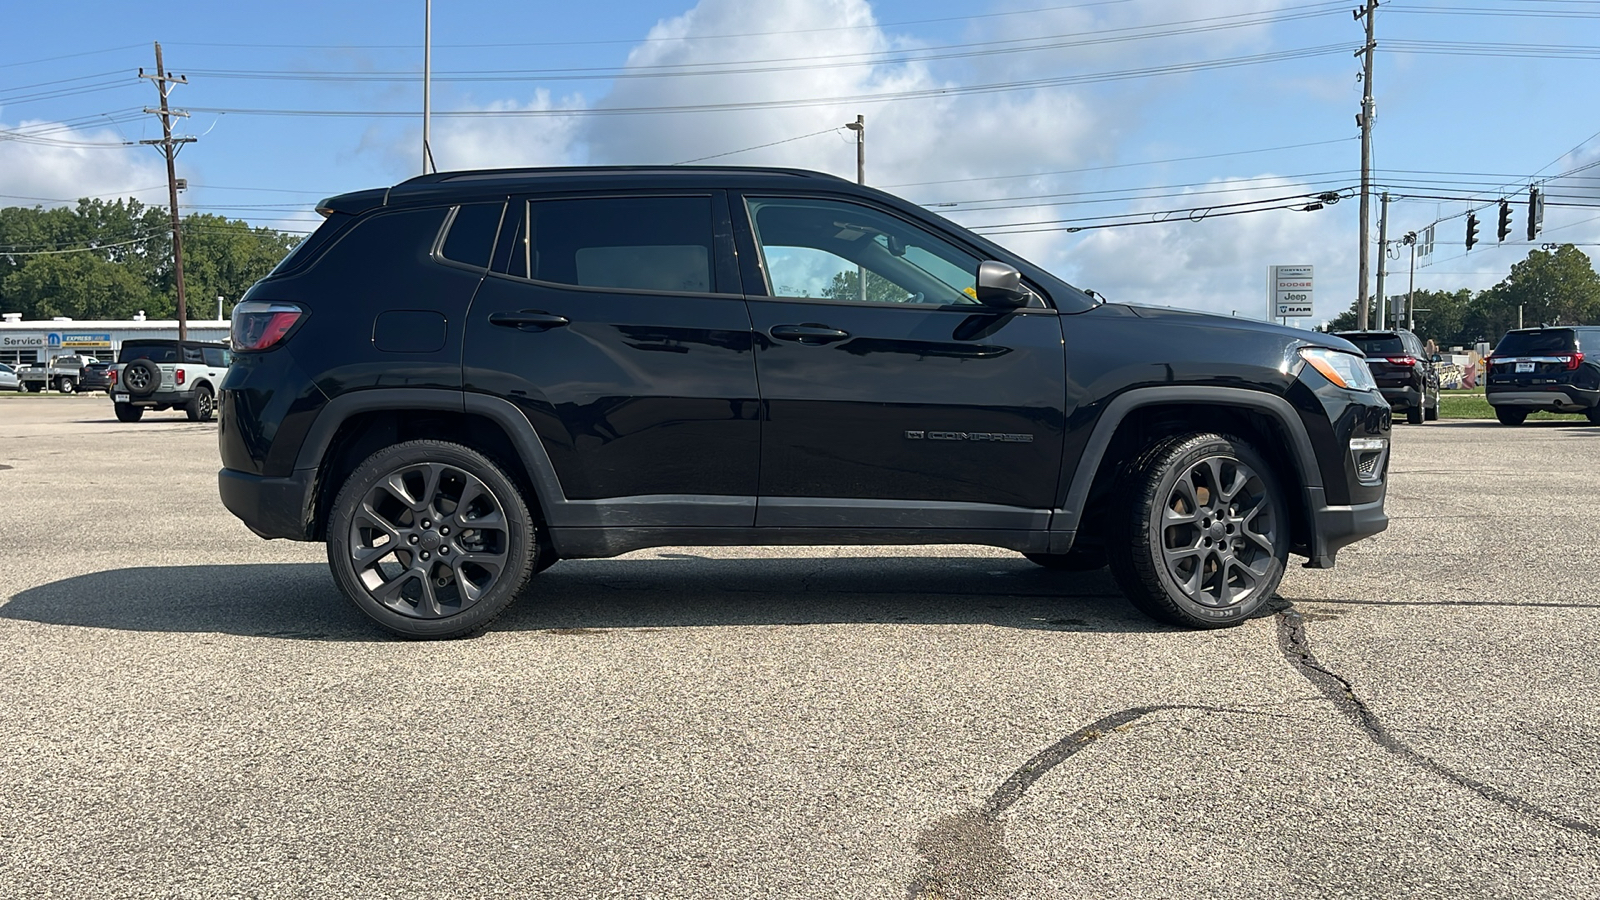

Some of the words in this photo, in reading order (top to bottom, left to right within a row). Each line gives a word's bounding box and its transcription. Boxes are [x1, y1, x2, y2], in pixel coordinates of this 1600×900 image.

[1284, 292, 1307, 302] Jeep
[4, 337, 43, 346] Service
[928, 431, 1034, 443] COMPASS
